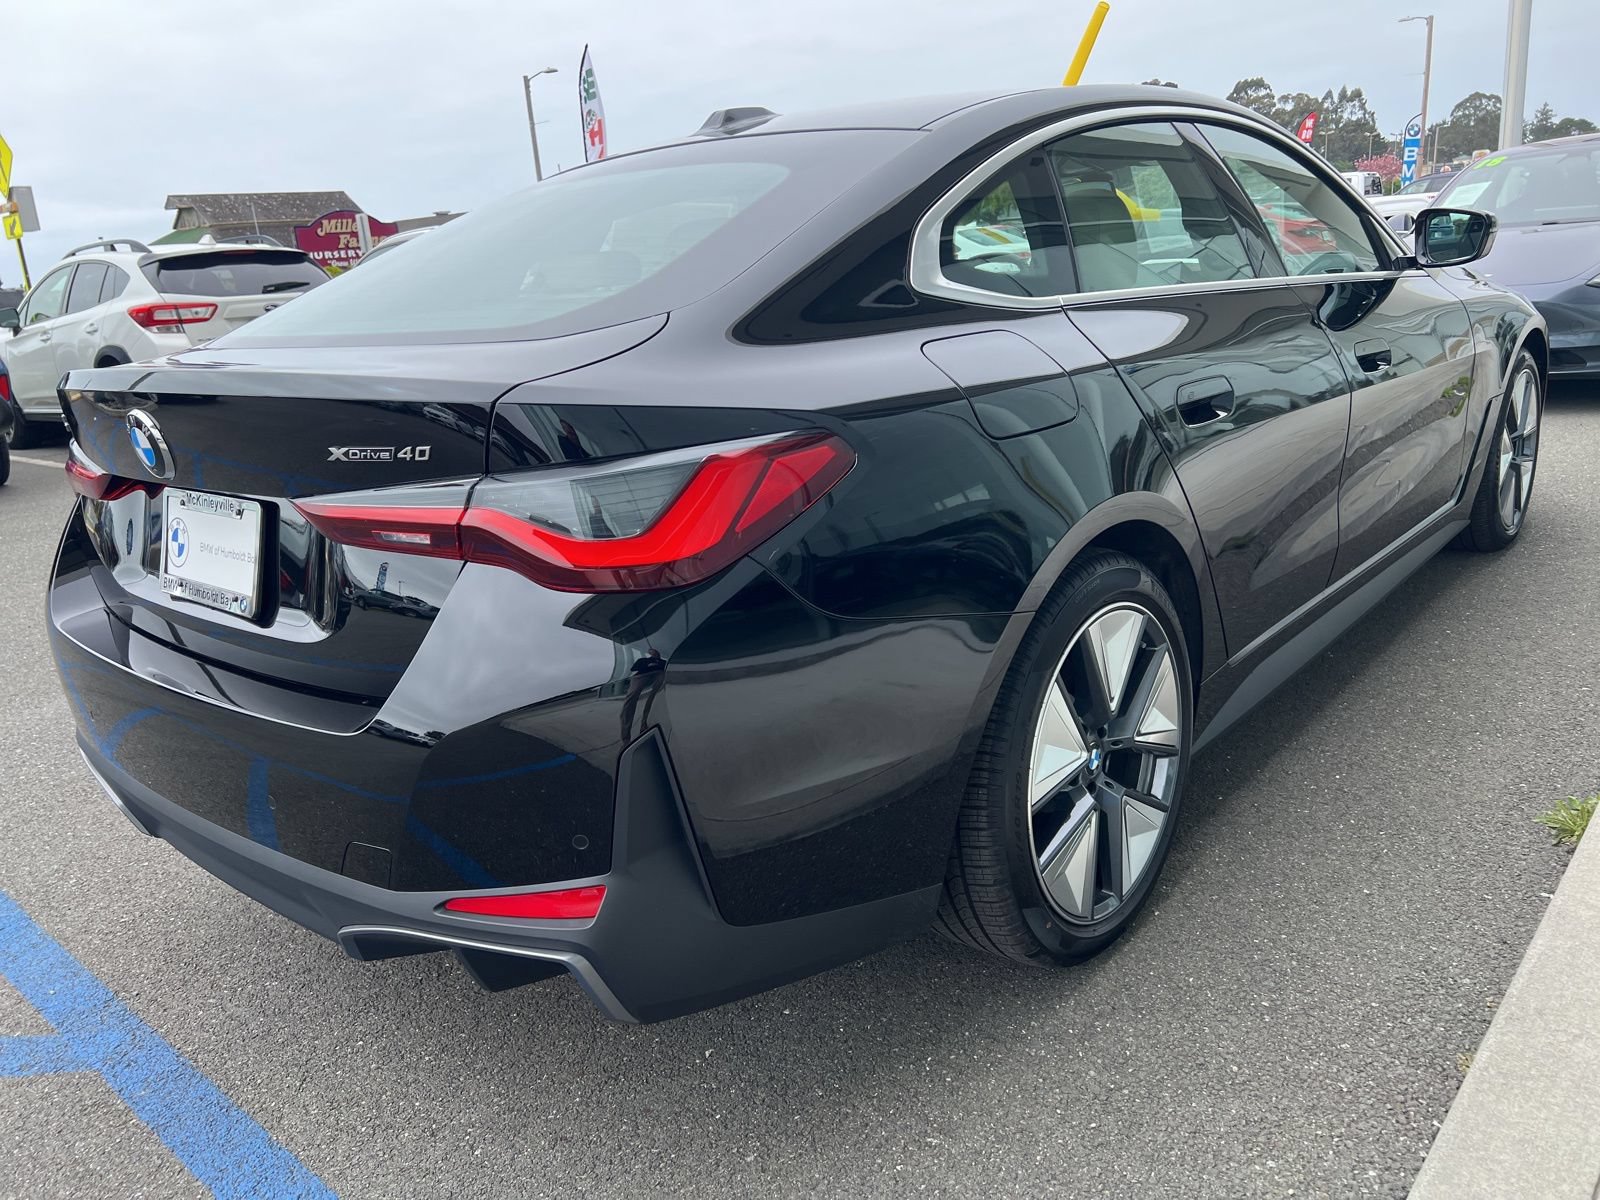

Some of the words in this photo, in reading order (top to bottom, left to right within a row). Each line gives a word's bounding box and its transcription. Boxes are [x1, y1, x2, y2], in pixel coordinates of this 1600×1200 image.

[317, 219, 359, 236] Mille
[397, 445, 432, 461] 40
[186, 492, 235, 512] McKinleyville
[200, 542, 213, 554] BMW
[221, 546, 246, 561] Humboldt
[189, 582, 219, 604] Humboldt
[220, 592, 233, 609] Bay
